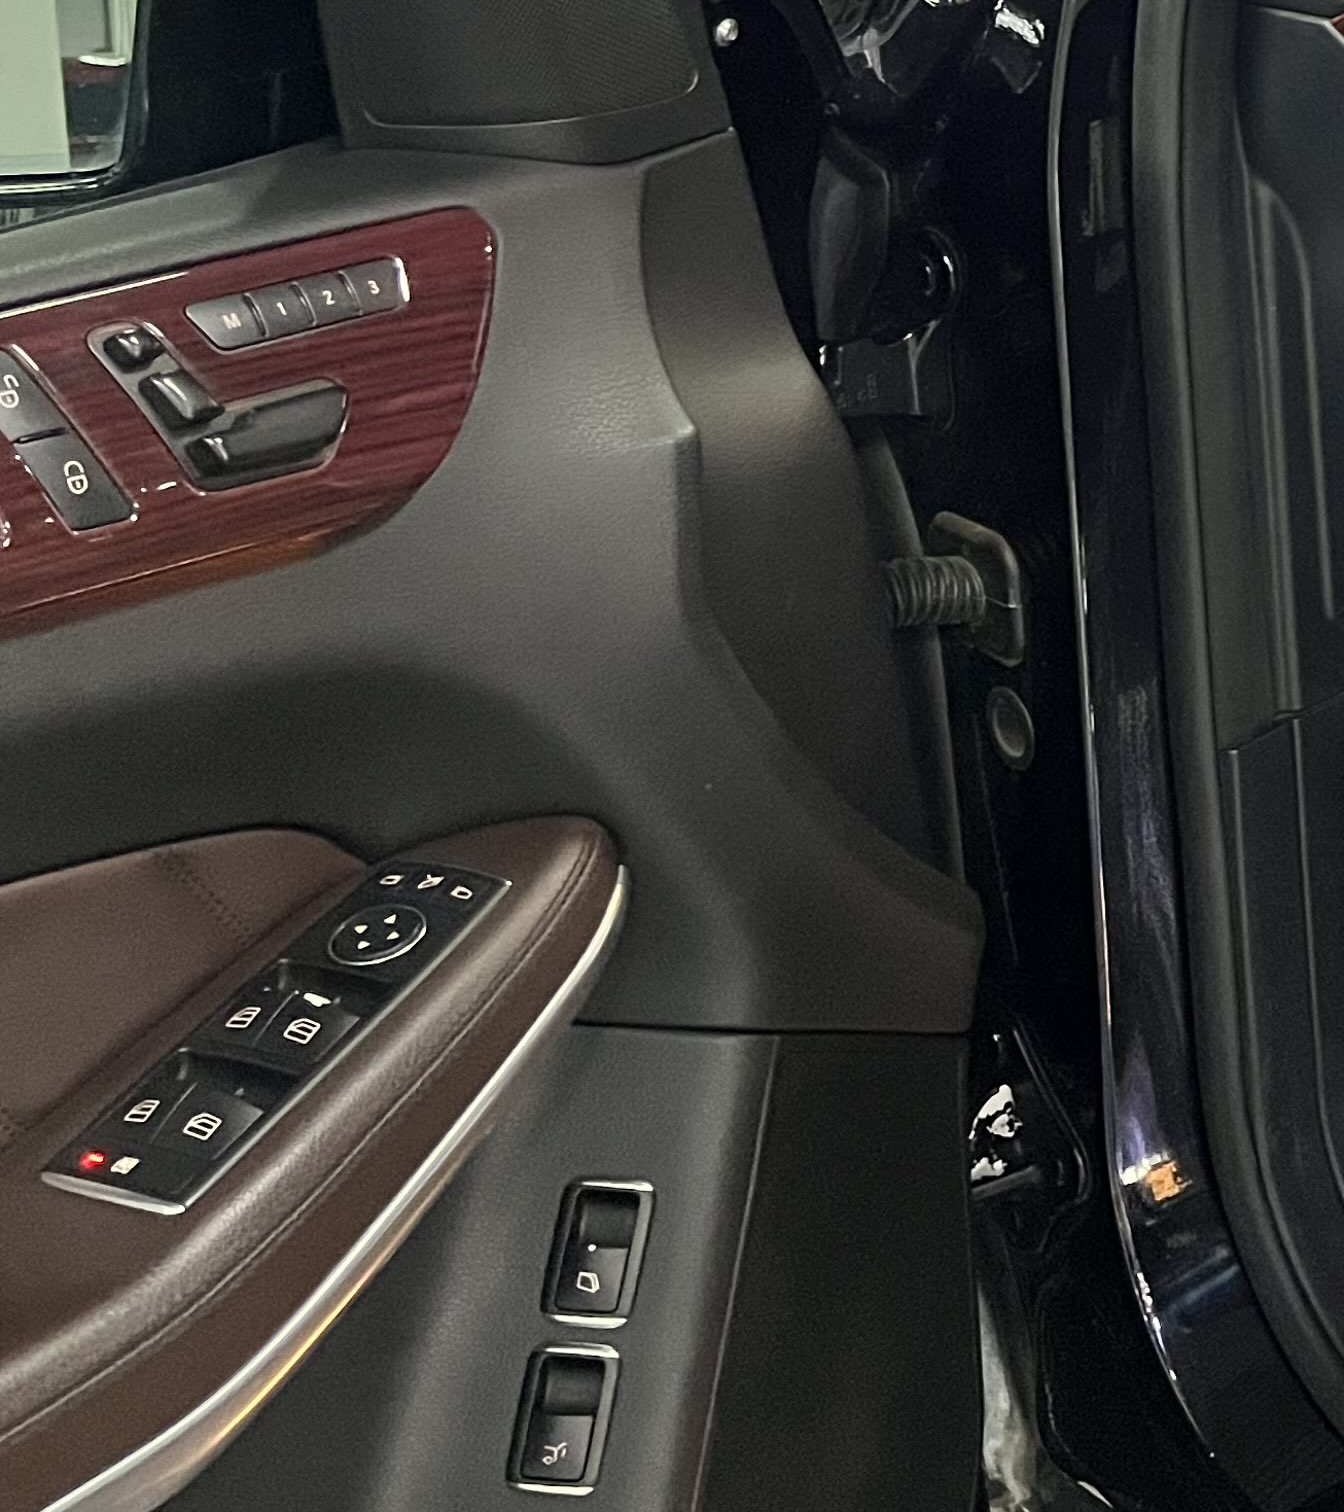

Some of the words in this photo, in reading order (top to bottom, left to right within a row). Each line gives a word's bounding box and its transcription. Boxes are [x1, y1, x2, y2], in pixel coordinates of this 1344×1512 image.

[223, 313, 242, 330] M
[276, 302, 286, 315] 1
[323, 290, 336, 305] 2
[367, 280, 381, 295] 3
